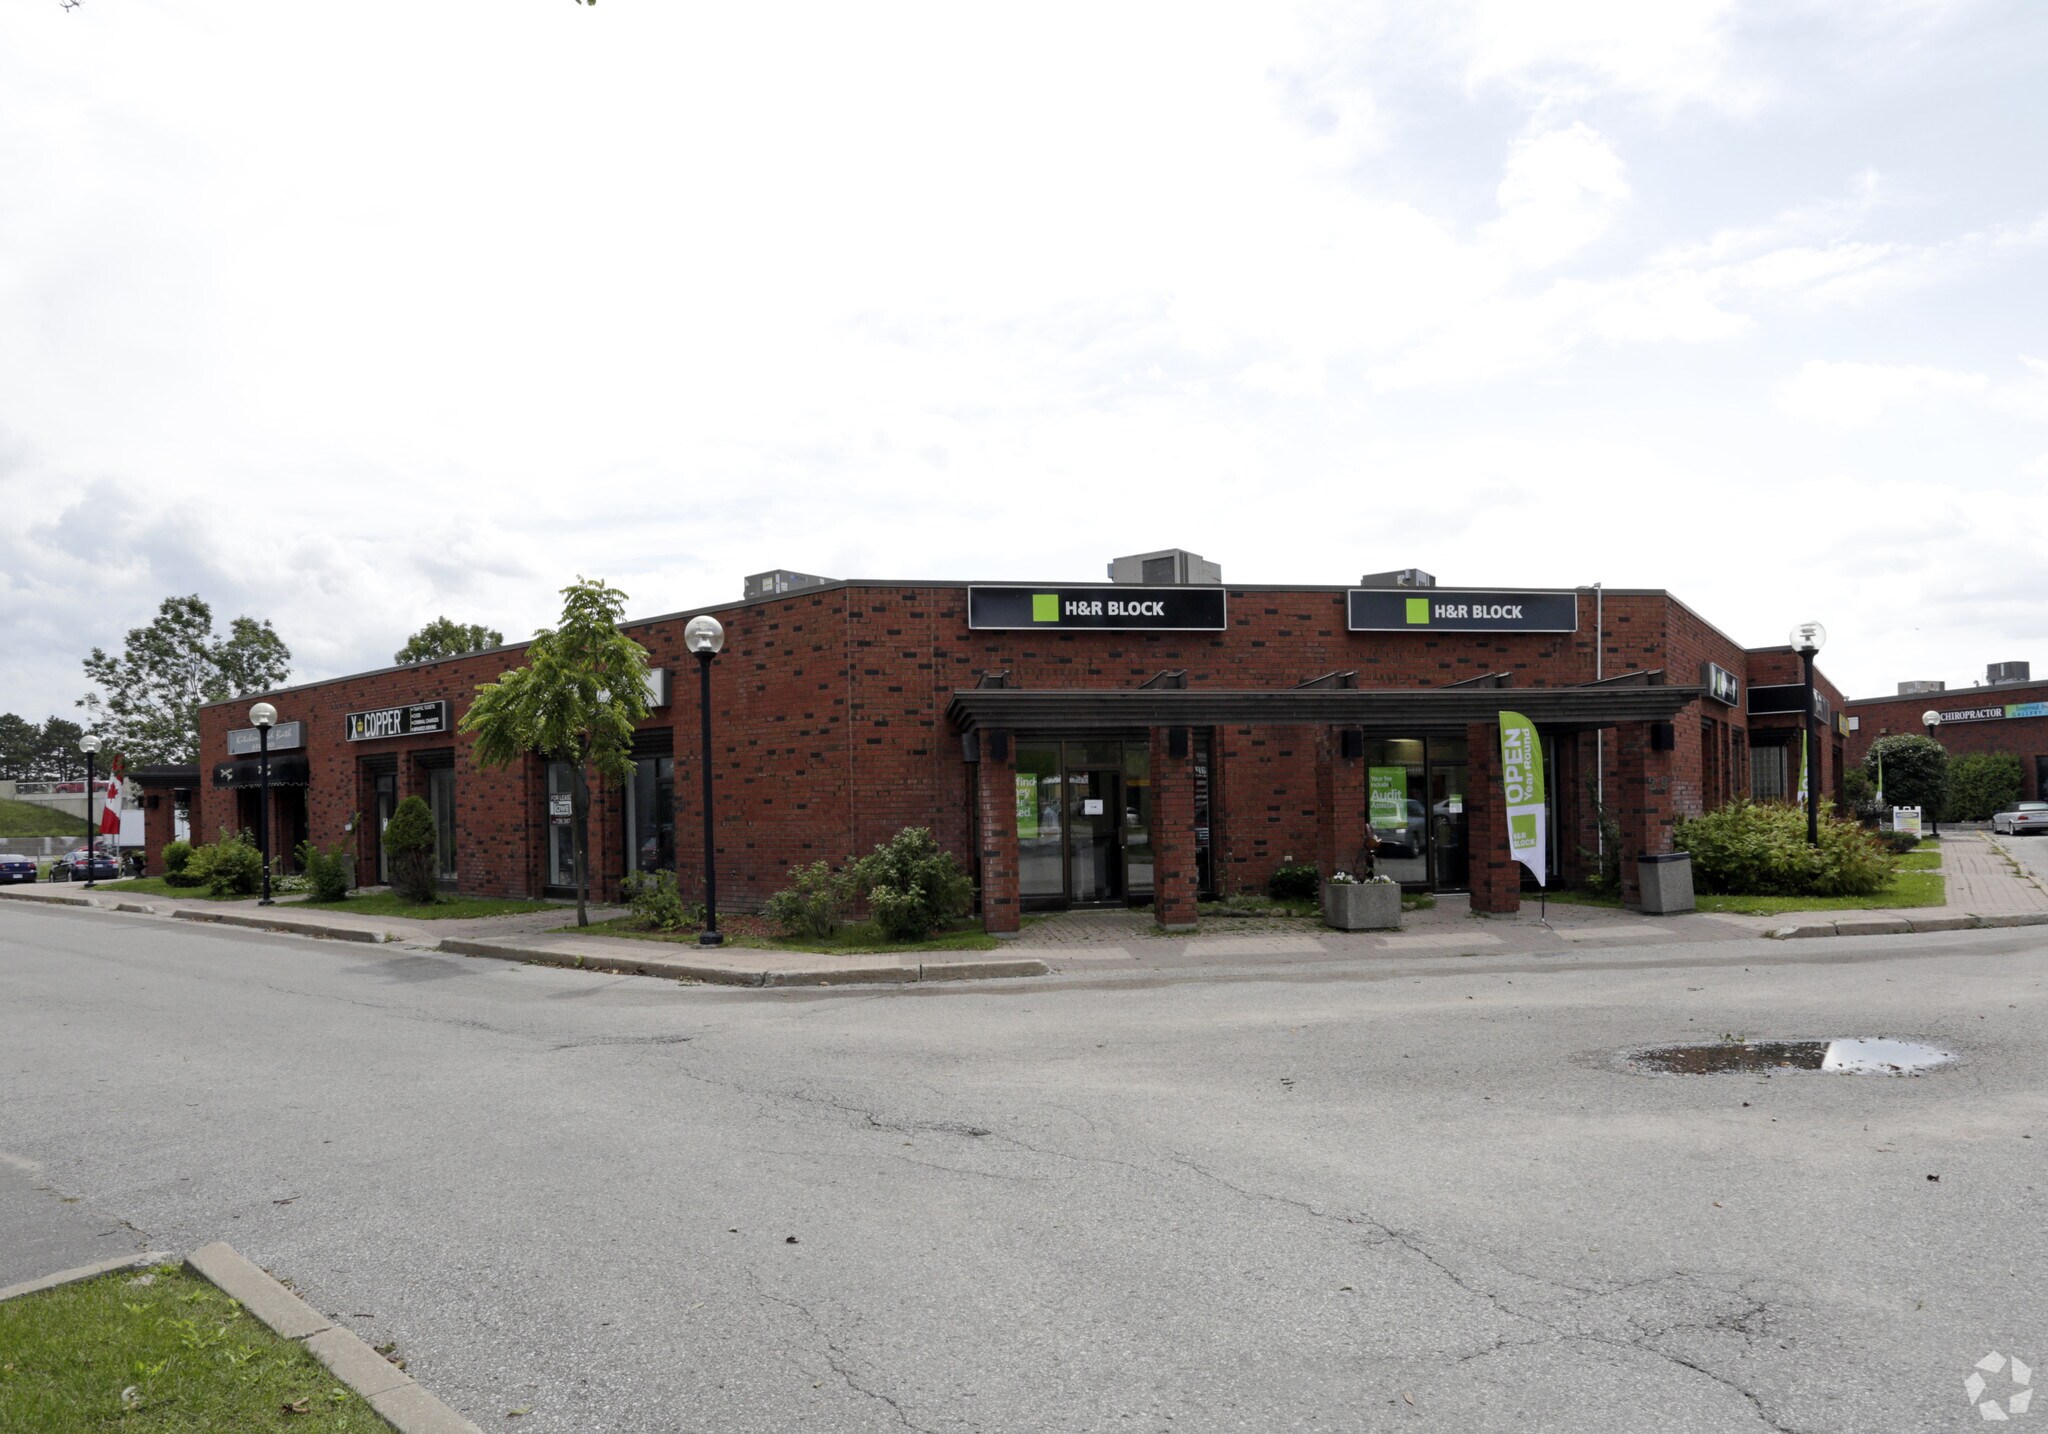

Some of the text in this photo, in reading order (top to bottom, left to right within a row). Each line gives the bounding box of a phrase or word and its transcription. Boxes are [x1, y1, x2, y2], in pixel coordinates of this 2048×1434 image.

[1065, 601, 1165, 616] H&R BLOCK
[1435, 604, 1523, 619] H&R BLOCK
[1940, 708, 2002, 721] CHIROPRACTOR
[364, 709, 401, 737] COPPER
[1505, 728, 1524, 803] OPEN
[1522, 728, 1533, 800] Year Round
[1372, 789, 1402, 801] Audit
[1513, 838, 1536, 848] BLOCK
